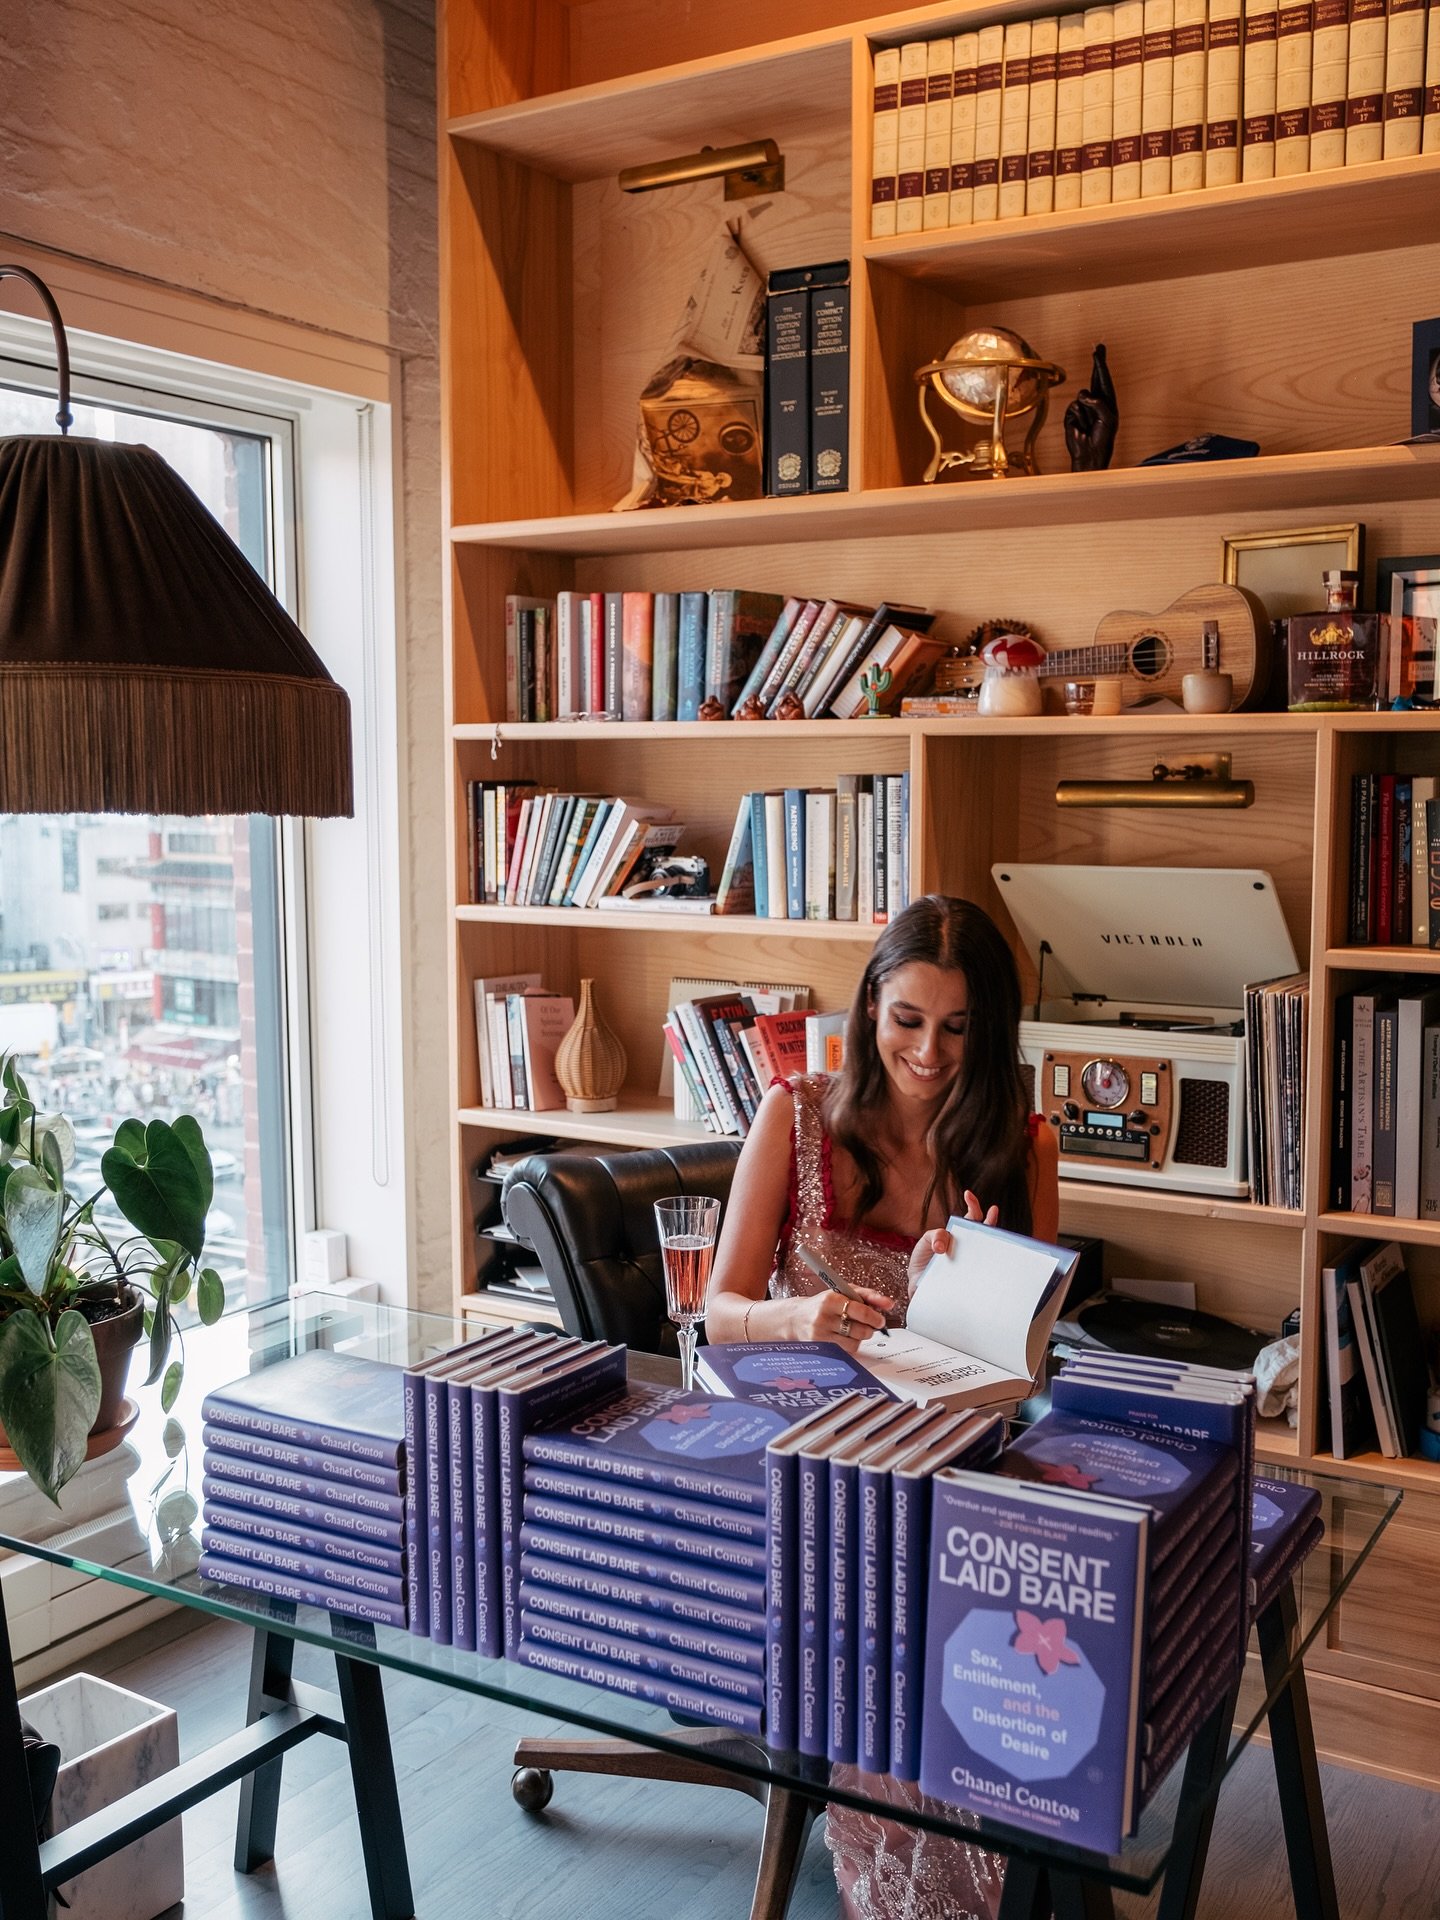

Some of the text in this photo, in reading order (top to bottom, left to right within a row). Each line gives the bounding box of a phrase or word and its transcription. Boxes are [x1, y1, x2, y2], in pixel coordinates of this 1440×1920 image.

[1360, 113, 1369, 122] 17
[1397, 107, 1407, 116] 18
[1120, 152, 1130, 161] 10
[1182, 142, 1191, 151] 12
[1253, 132, 1264, 141] 14
[1297, 650, 1365, 661] HILLROCK
[790, 805, 798, 852] PARTNERING
[1100, 933, 1203, 948] VICTROLA
[776, 1344, 820, 1352] Chanel
[951, 1364, 982, 1374] LAID
[748, 1390, 823, 1403] BARE
[913, 1372, 951, 1384] BARE
[927, 1368, 986, 1387] CONSENT
[570, 1386, 665, 1436] CONSENT
[586, 1388, 691, 1444] LAID BARE
[209, 1407, 384, 1459] CONSENT LAID BARE Chanel Contos
[1079, 1418, 1198, 1453] Chanel Contos
[209, 1433, 386, 1486] CONSENT LAID BARE Chanel Contos
[533, 1445, 753, 1504] CONSENT LAID BARE Chanel Contos
[209, 1484, 388, 1538] CONSENT LAID BARE Chanel Contos
[451, 1398, 465, 1637] CONSENT LAID BARE Chanel Contos
[500, 1405, 515, 1647] CONSENT LAID BARE Chanel Contos
[534, 1476, 753, 1536] CONSENT LAID BARE Chanel Contos
[534, 1506, 754, 1567] CONSENT LAID BARE Chanel Contos
[946, 1525, 1111, 1589] CONSENT
[770, 1467, 783, 1734] CONSENT LAID BARE Chanel Contos
[803, 1471, 815, 1739] CONSENT LAID BARE Chanel Contos
[939, 1552, 1117, 1624] LAID BARE
[864, 1485, 877, 1758] CONSENT LAID BARE Chanel Contos
[953, 1663, 1042, 1700] Entitlement,
[970, 1649, 1003, 1671] Sex,
[528, 1651, 745, 1725] CONSENT LAID BARE Chanel Contos
[1002, 1697, 1061, 1722] and the
[972, 1706, 1068, 1745] Distortion of
[1001, 1733, 1050, 1761] Desire
[951, 1766, 1011, 1801] Chanel
[1015, 1787, 1080, 1822] Contos
